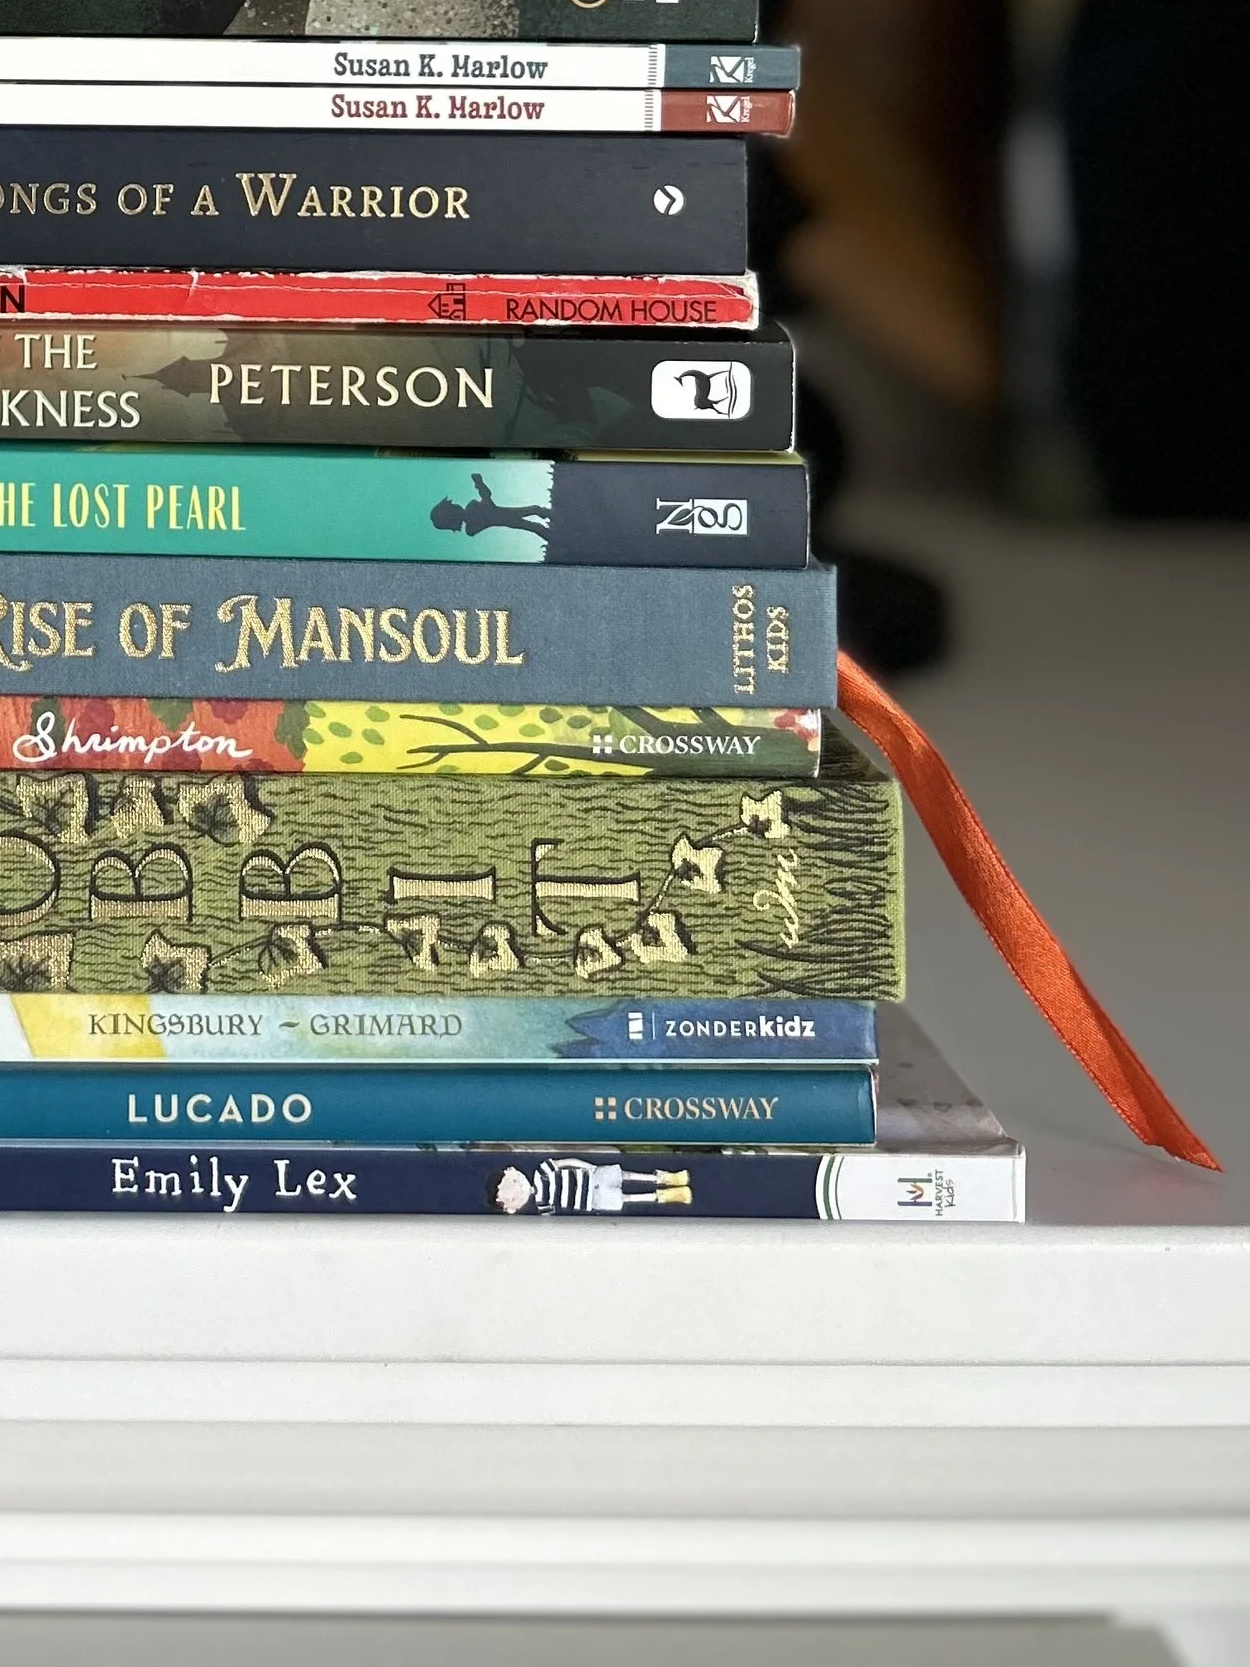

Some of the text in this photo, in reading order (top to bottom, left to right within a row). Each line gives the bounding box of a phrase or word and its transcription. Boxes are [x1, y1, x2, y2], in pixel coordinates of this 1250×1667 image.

[333, 54, 548, 80] Susan K. Marlow
[744, 57, 755, 83] Kregel
[118, 184, 174, 215] OF
[191, 185, 219, 216] A
[235, 173, 470, 219] WARRIOR
[505, 297, 717, 322] RANDOM HOUSE
[19, 334, 98, 369] THE
[209, 365, 494, 408] PETERSON
[52, 483, 129, 530] LOST
[146, 485, 246, 531] PEARL
[119, 603, 193, 661] OF
[215, 594, 525, 674] MANSOUL
[732, 584, 755, 696] LITHOS
[767, 606, 789, 674] KIDS
[12, 711, 254, 764] Shrimpton
[620, 735, 761, 755] CROSSWAY
[90, 1012, 463, 1038] KINGSBURY GRIMARD
[128, 1093, 313, 1124] LUCADO
[624, 1096, 780, 1121] CROSSWAY
[113, 1157, 357, 1212] Emily Lex
[934, 1168, 945, 1216] HARVEST
